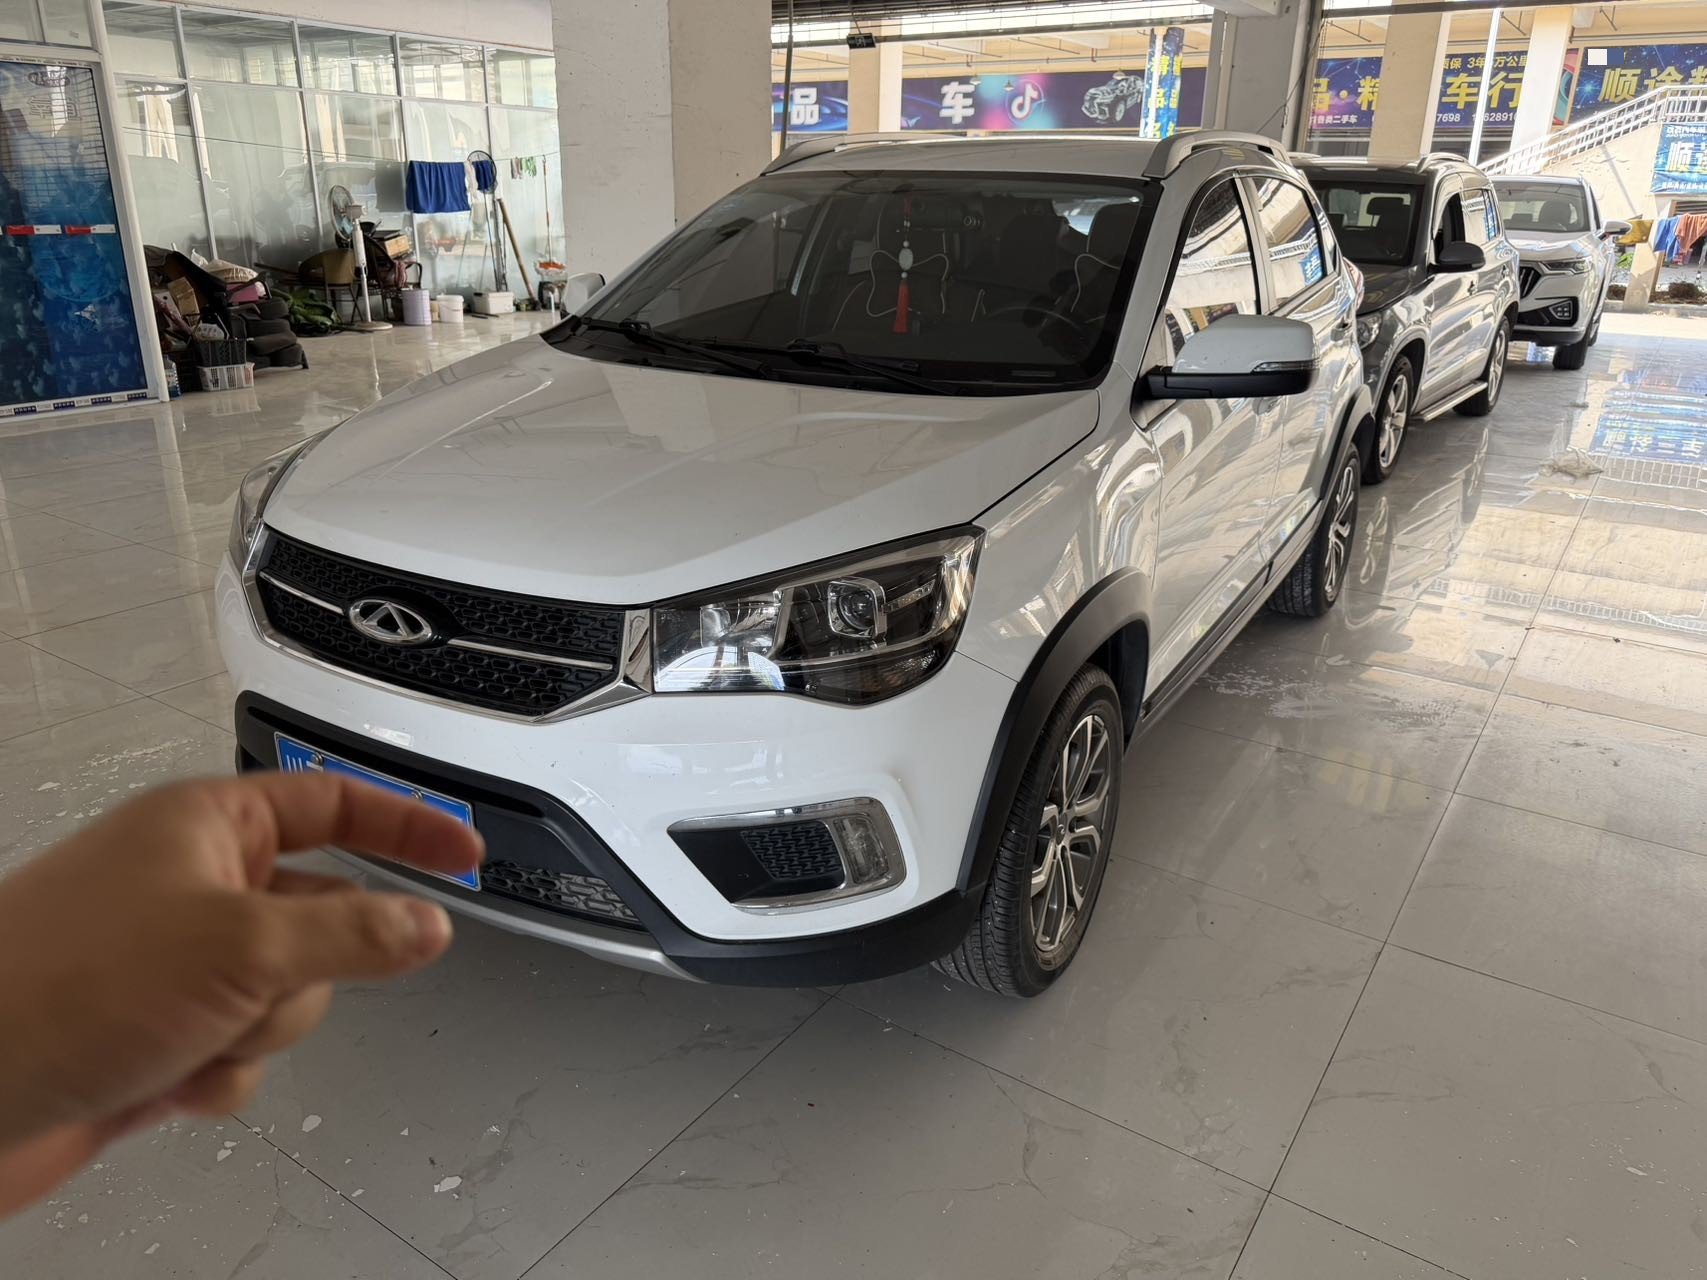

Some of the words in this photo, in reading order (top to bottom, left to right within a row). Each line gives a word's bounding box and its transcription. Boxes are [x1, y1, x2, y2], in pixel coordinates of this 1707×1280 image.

[790, 87, 820, 125] 品
[939, 81, 975, 124] 车
[1441, 72, 1524, 110] 车行
